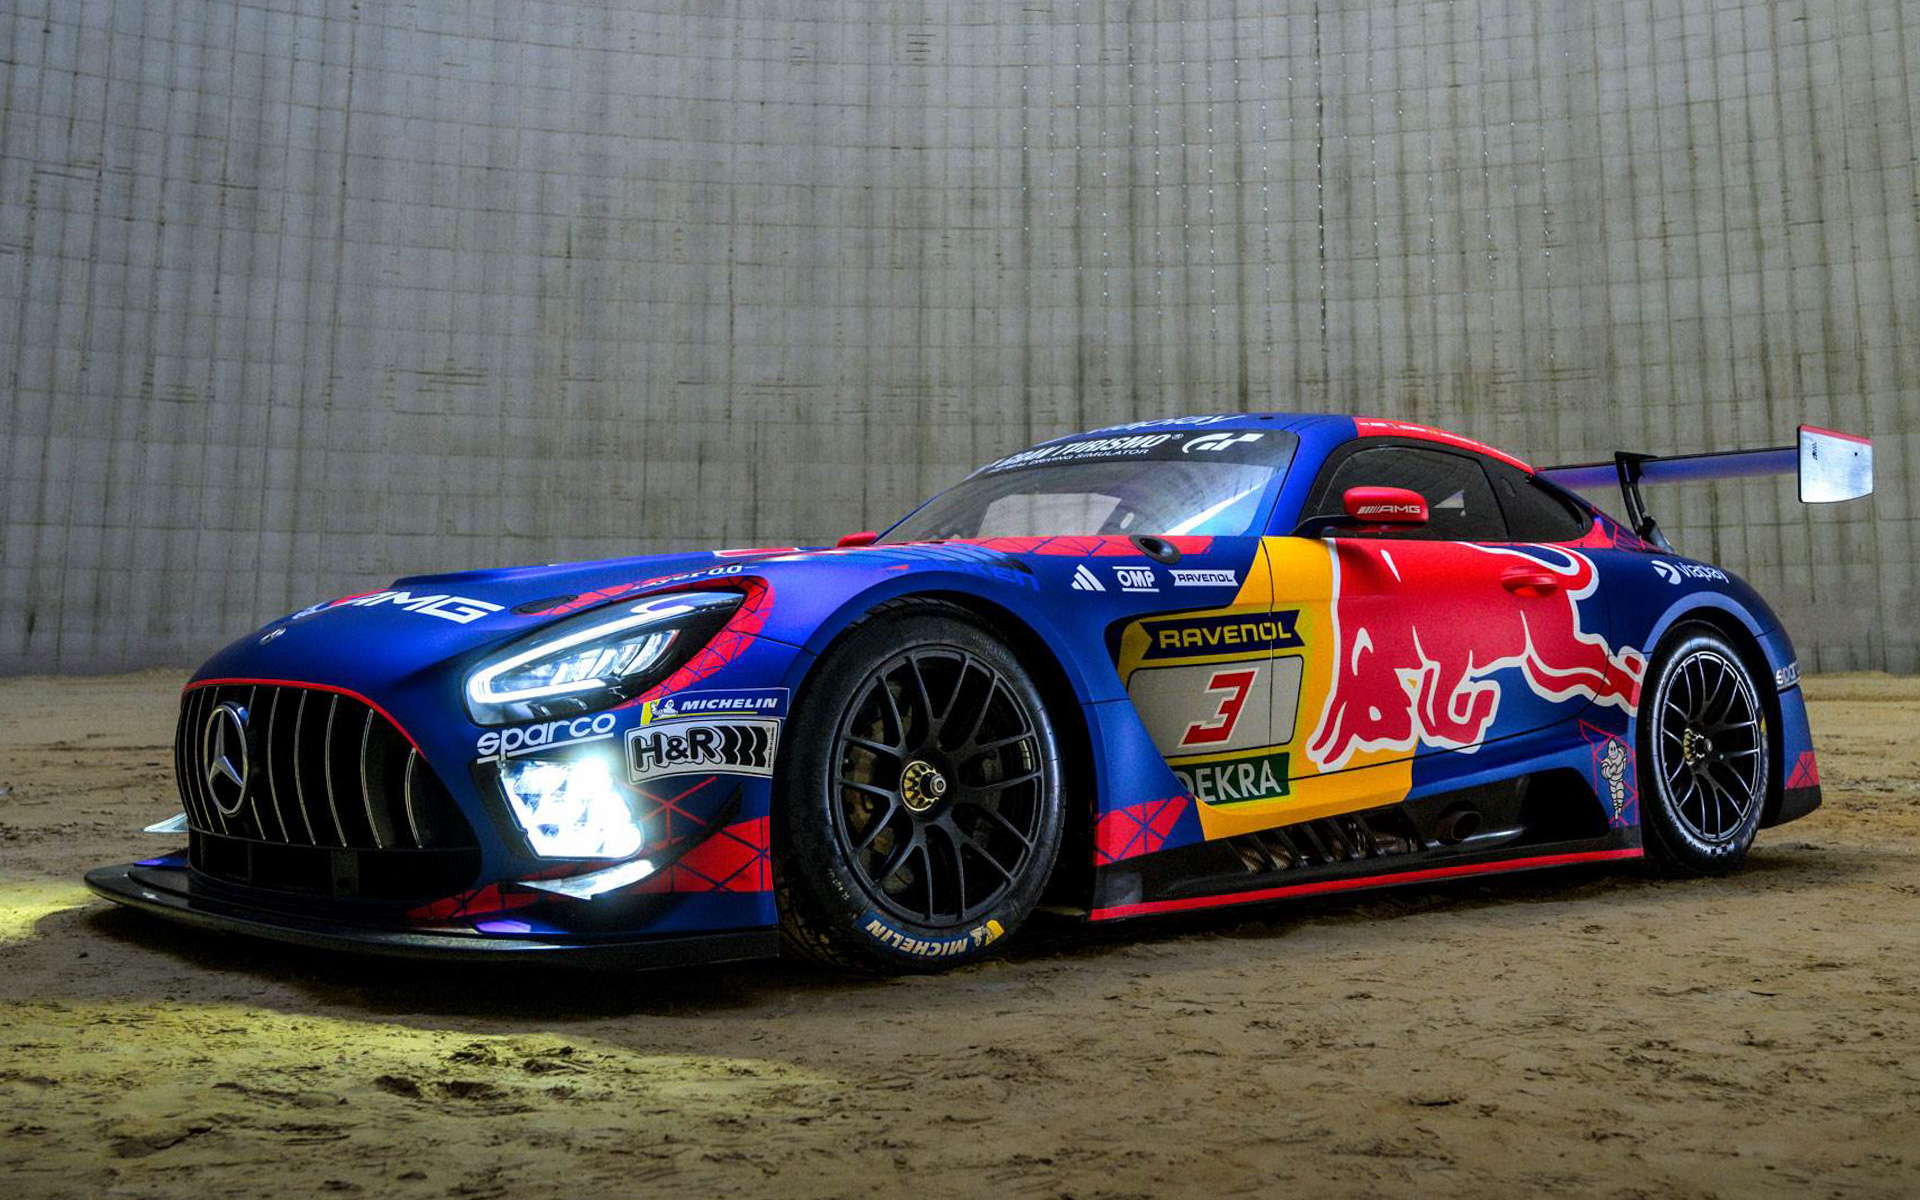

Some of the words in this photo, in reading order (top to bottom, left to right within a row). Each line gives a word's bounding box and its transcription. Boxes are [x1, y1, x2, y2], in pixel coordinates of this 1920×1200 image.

[1051, 434, 1171, 457] TURISMO
[1075, 449, 1150, 461] SIMULATOR
[1117, 570, 1156, 588] OMP
[1178, 573, 1234, 583] RAVENOL
[1159, 621, 1292, 649] RAVENOL
[681, 698, 778, 711] MICHELIN
[1177, 667, 1260, 748] 3
[477, 712, 616, 762] sparco
[633, 726, 720, 772] H&R
[865, 919, 968, 957] MICHELIN
